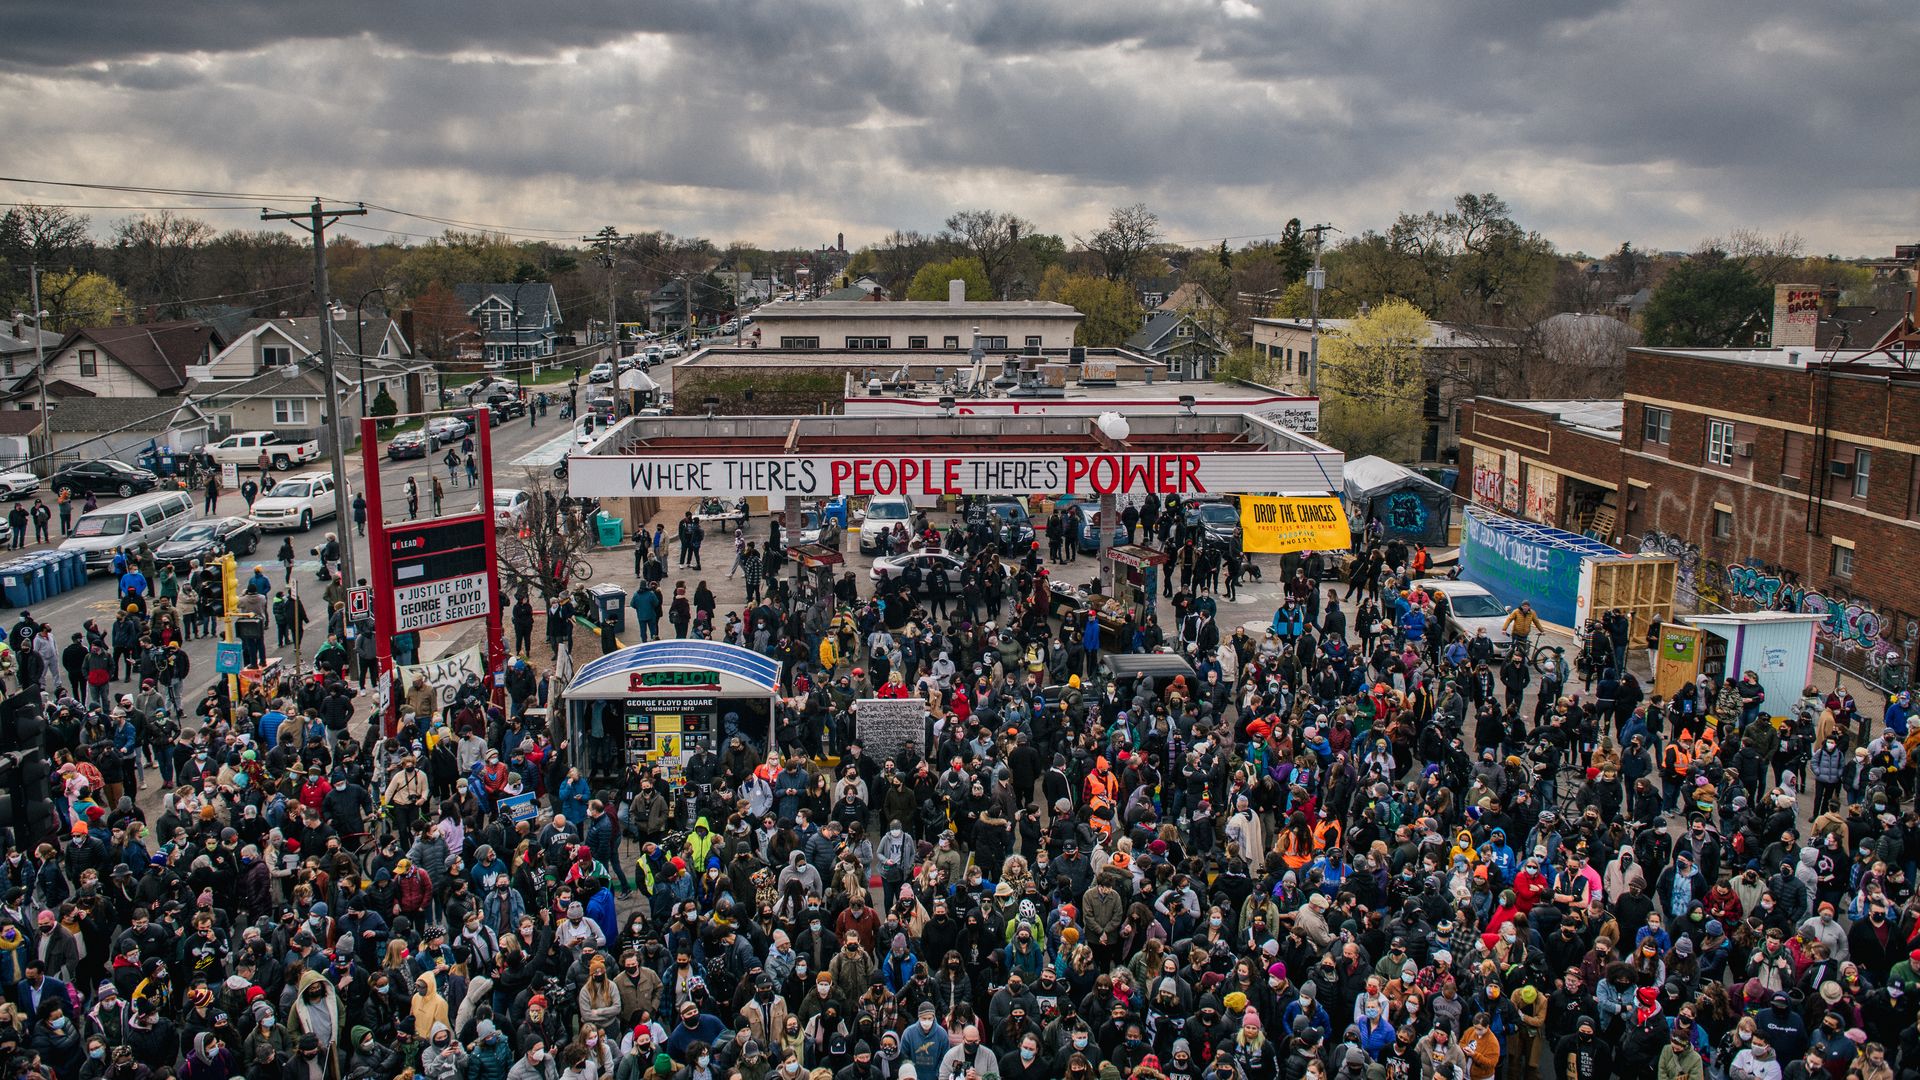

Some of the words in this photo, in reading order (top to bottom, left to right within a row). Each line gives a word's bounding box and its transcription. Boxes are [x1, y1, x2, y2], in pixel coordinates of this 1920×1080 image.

[1788, 300, 1818, 313] BACK
[1285, 409, 1311, 418] Belongs
[629, 462, 713, 491] WHERE
[723, 459, 817, 494] THERE'S
[831, 459, 962, 495] PEOPLE
[968, 460, 1058, 490] THERE'S
[1062, 455, 1207, 494] POWER
[1254, 504, 1276, 523] DROP
[1279, 504, 1296, 523] THE
[1297, 504, 1337, 523] CHARGES
[1509, 540, 1549, 573] TONGUE
[409, 582, 450, 600] JUSTICE
[455, 578, 473, 591] FOR
[401, 598, 440, 616] GEORGE
[448, 590, 481, 606] FLOYD
[401, 611, 441, 629] JUSTICE
[445, 602, 486, 620] SERVED?
[1767, 1023, 1798, 1033] Champion
